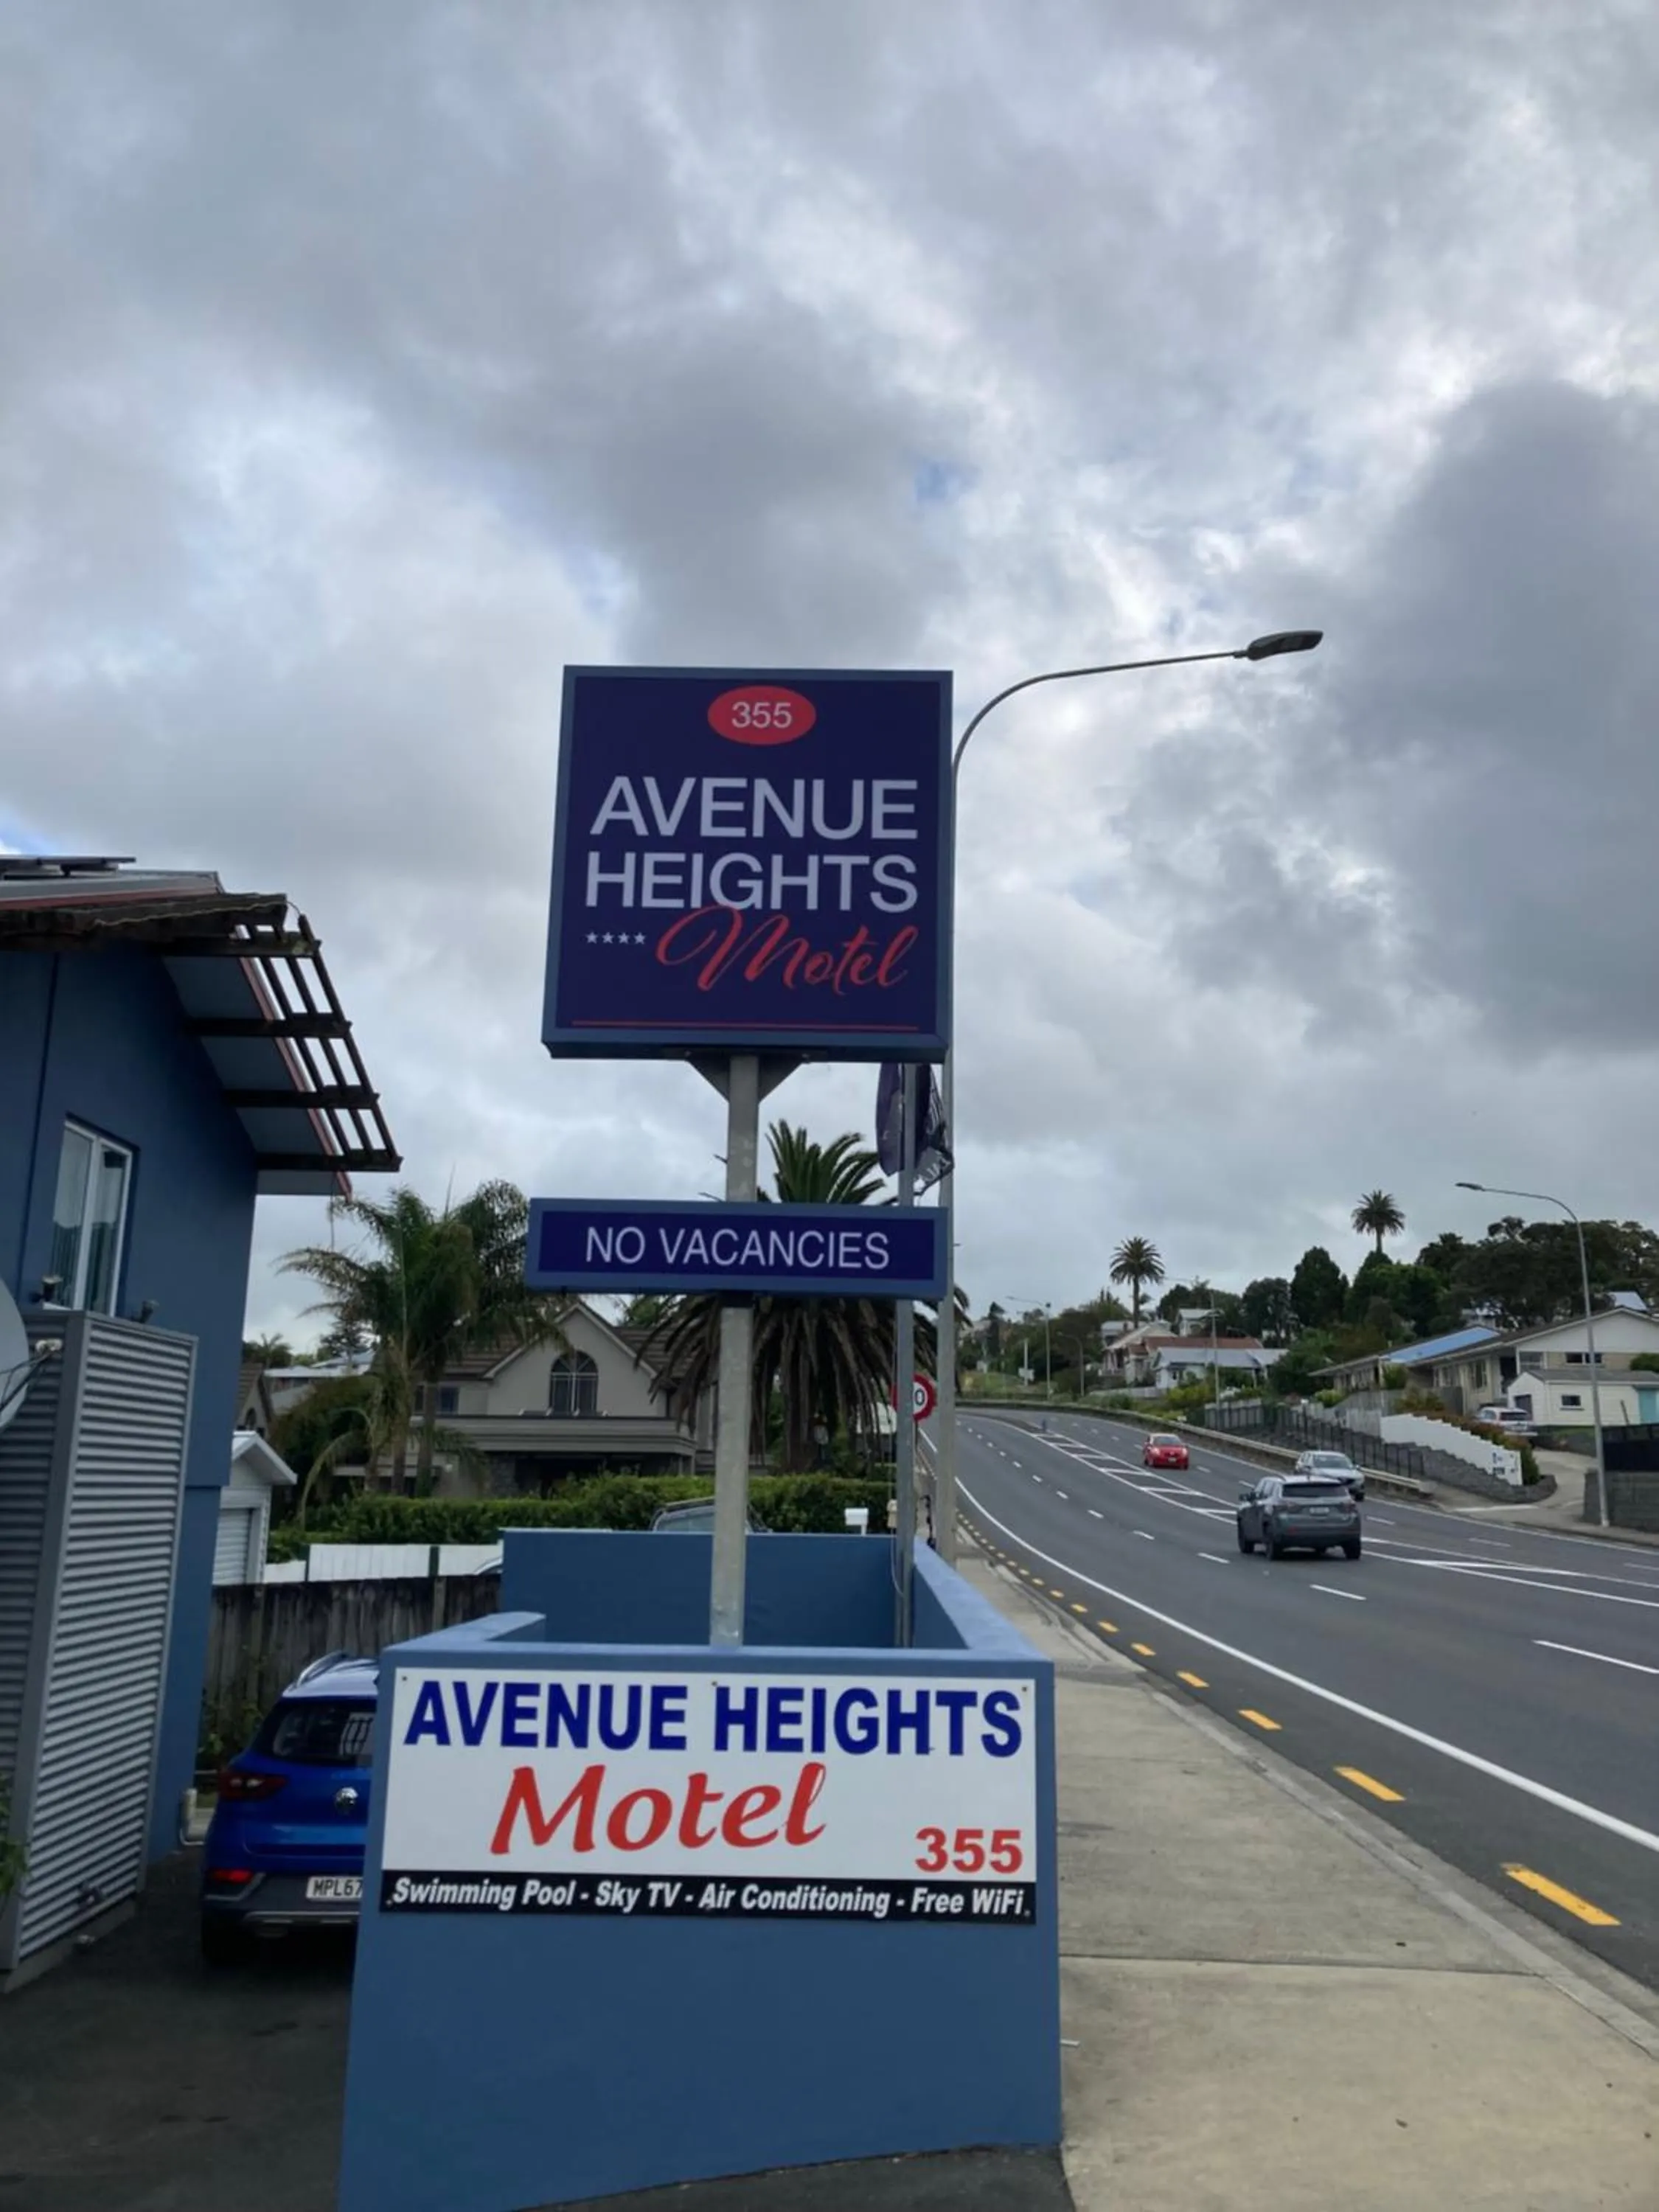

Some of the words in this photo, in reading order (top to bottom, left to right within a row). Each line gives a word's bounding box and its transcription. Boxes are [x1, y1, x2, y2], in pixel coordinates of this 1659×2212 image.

[731, 701, 792, 728] 355
[589, 776, 918, 840] AVENUE
[585, 851, 918, 913] HEIGHTS
[655, 904, 919, 996] Motel
[586, 1226, 645, 1264] NO
[659, 1228, 889, 1270] VACANCIES
[403, 1681, 688, 1750] AVENUE
[713, 1686, 1023, 1757] HEIGHTS
[490, 1762, 827, 1855] Motel
[915, 1827, 1023, 1874] 355
[392, 1877, 517, 1912] Swimming
[522, 1879, 577, 1906] Pool
[595, 1880, 641, 1913] Sky
[647, 1882, 682, 1907] TV
[698, 1882, 736, 1909] Air
[740, 1883, 891, 1919] Conditioning
[911, 1887, 964, 1914] Free
[971, 1888, 1025, 1915] WiFi
